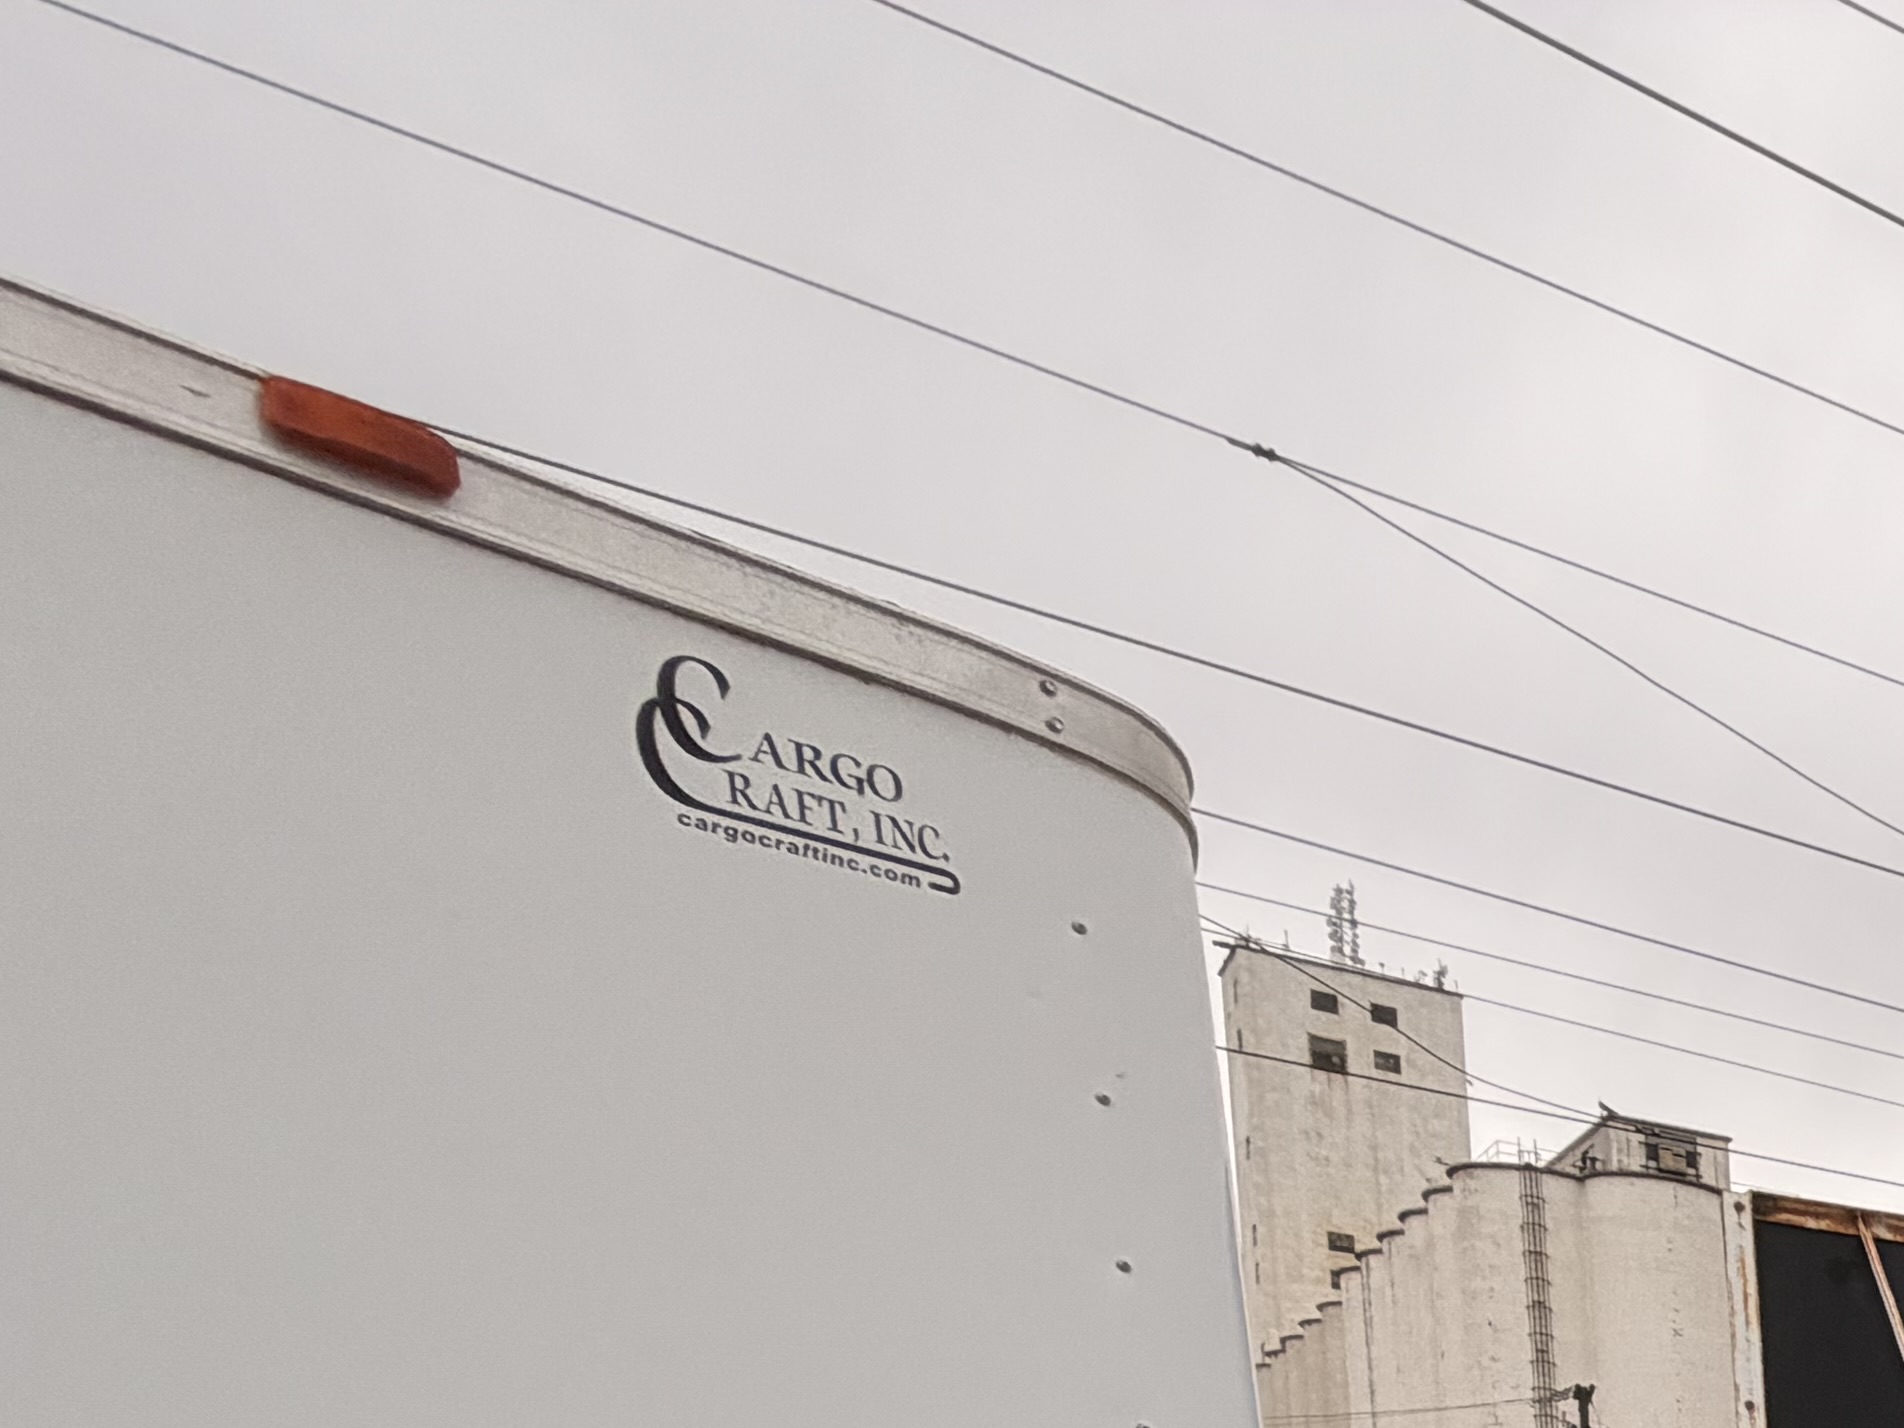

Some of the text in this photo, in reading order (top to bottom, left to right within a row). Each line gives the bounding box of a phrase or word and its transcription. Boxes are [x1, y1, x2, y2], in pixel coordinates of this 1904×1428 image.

[656, 655, 903, 804] CARGO
[676, 811, 922, 891] cargocraftinc.com
[873, 809, 952, 863] INC.
